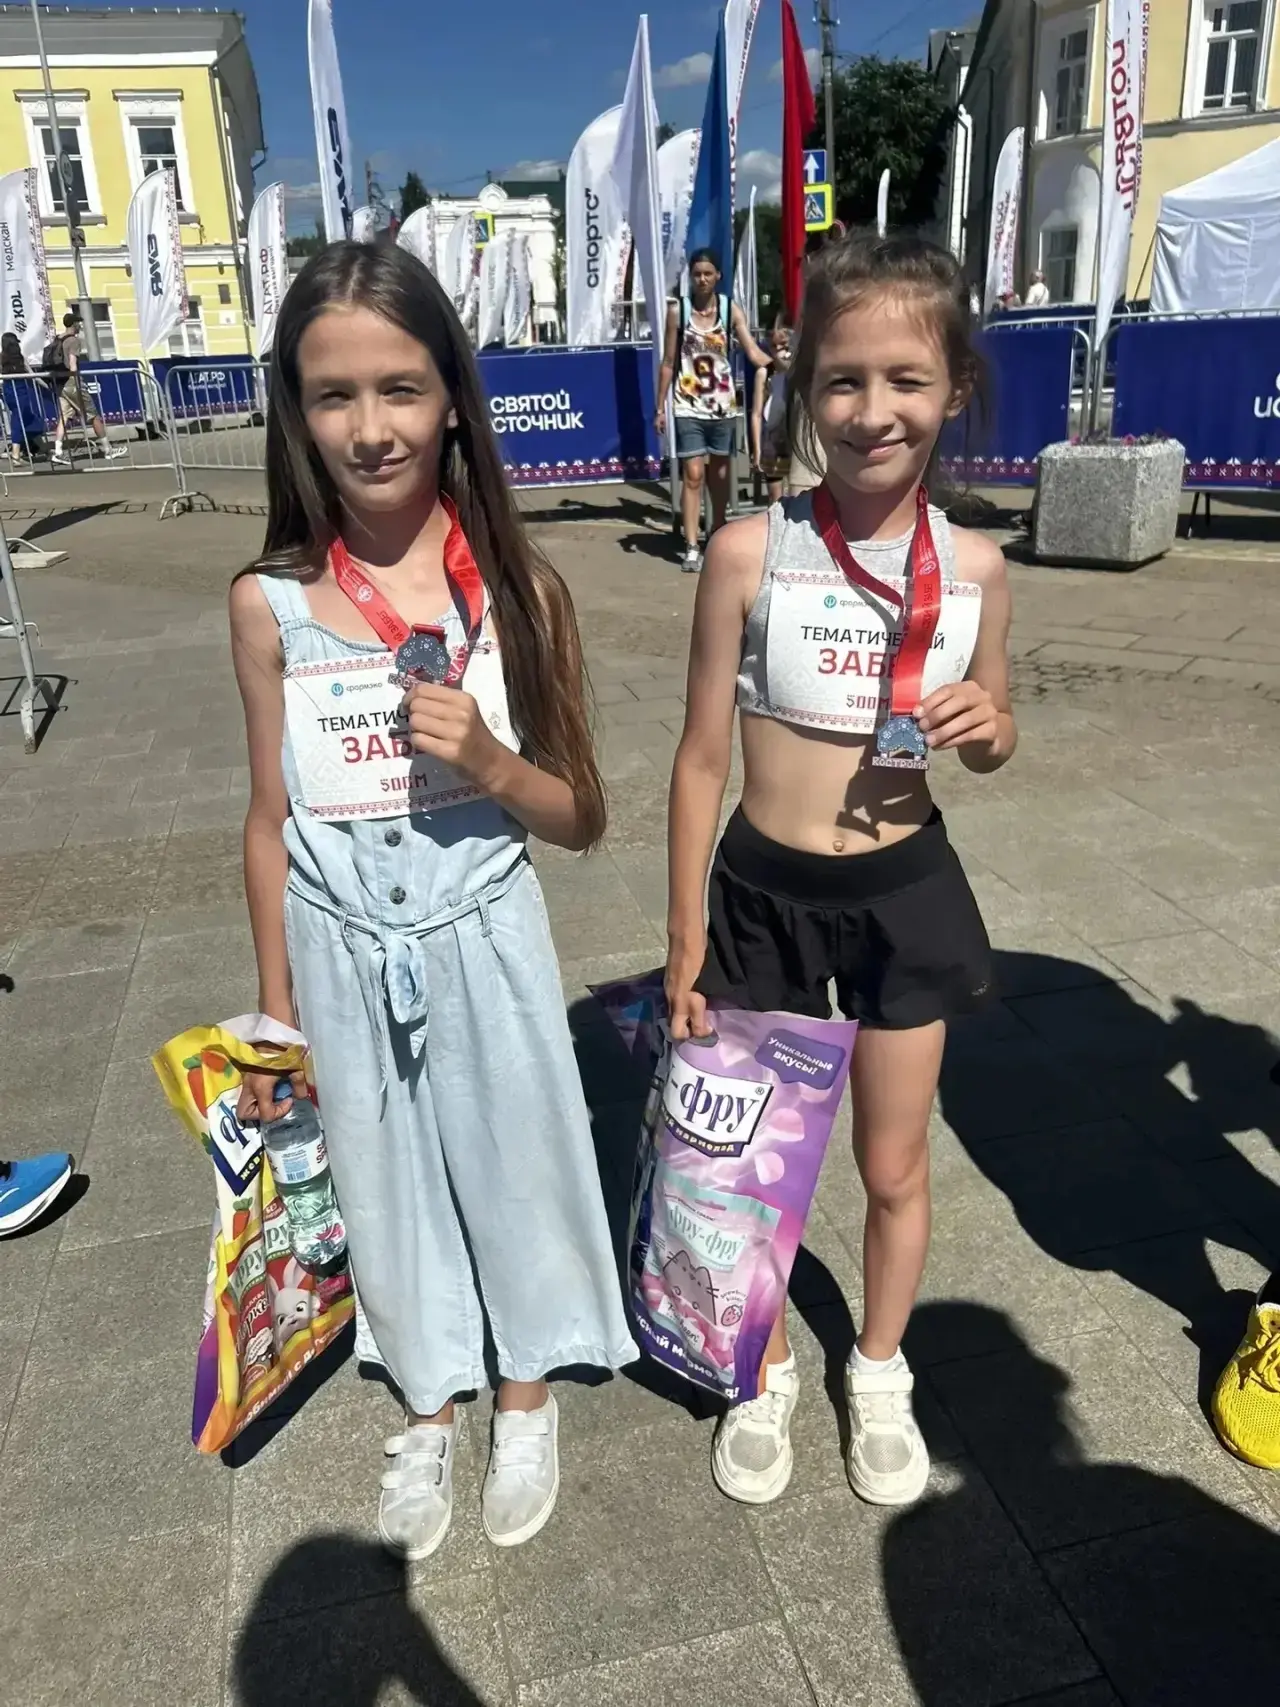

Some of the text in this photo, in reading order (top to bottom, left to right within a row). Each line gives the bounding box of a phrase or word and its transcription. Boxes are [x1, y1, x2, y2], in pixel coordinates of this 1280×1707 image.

[147, 233, 163, 297] ЯМЗ
[260, 248, 274, 315] АГАТ.РФ
[13, 290, 25, 318] KDL
[490, 388, 570, 414] СВЯТОЙ
[490, 412, 585, 434] СТОЧНИК
[801, 625, 945, 650] ТЕМАТИЧЕЙ
[818, 648, 895, 679] ЗАБ
[317, 709, 409, 732] ТЕМАТИЧ
[341, 731, 424, 764] ЗАБ
[872, 755, 929, 770] КОСТРОМА
[768, 1037, 833, 1071] Уникальные
[773, 1051, 818, 1075] вкусы!
[671, 1074, 760, 1133] -фру
